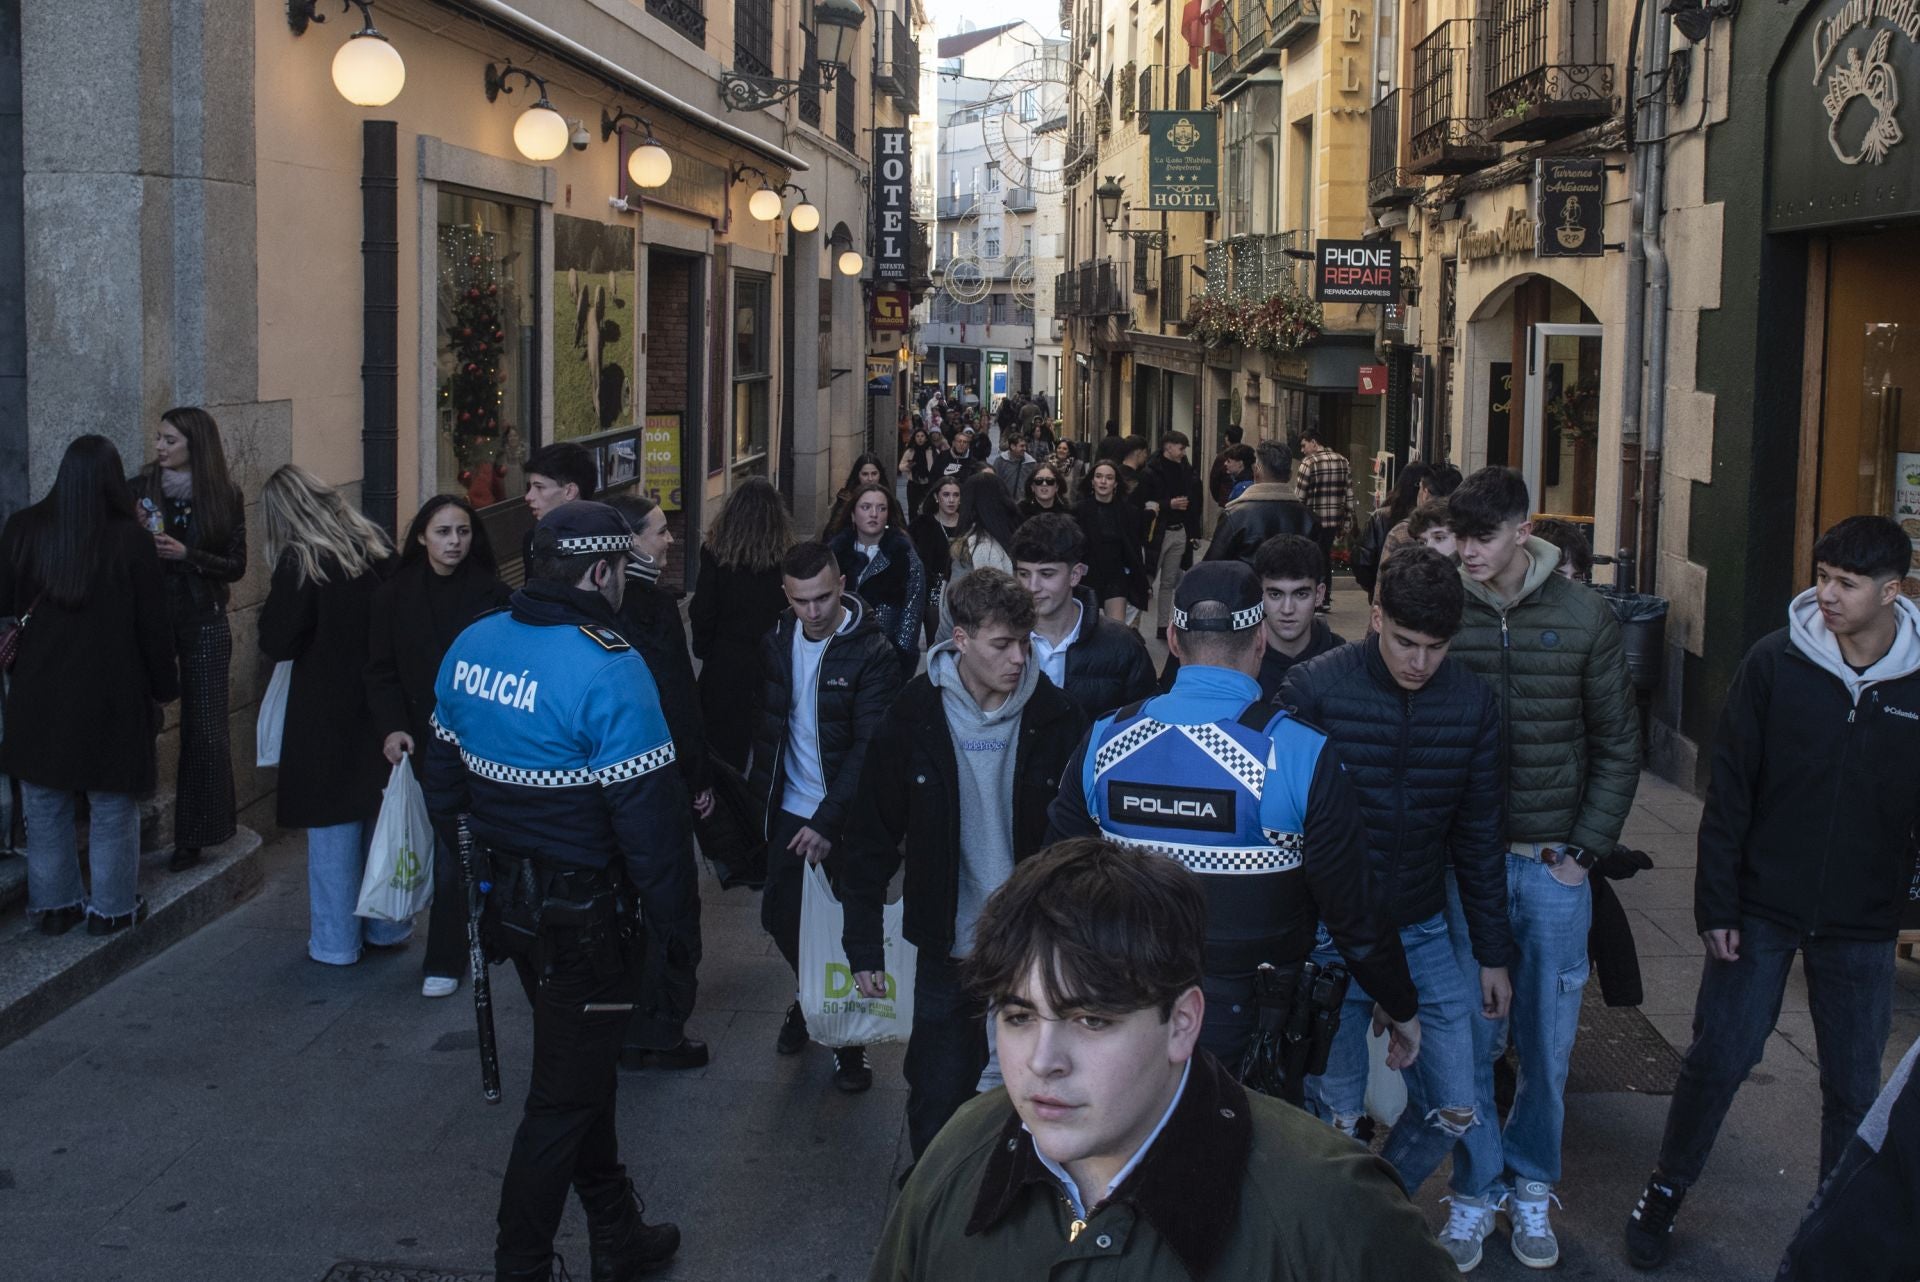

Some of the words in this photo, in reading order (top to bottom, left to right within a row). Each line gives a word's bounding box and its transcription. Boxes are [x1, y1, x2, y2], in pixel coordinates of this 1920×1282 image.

[1546, 180, 1600, 193] Artesanos
[882, 133, 904, 258] HOTEL
[1154, 193, 1215, 206] HOTEL
[1325, 248, 1391, 267] PHONE
[1325, 267, 1392, 286] REPAIR
[1324, 288, 1362, 296] REPARACIÓN
[1363, 289, 1391, 297] EXPRESS
[868, 363, 892, 374] ATM
[646, 449, 672, 461] rico
[453, 660, 538, 713] POLICÍA
[1889, 706, 1919, 720] Columbia
[1123, 796, 1217, 818] POLICIA
[823, 1001, 867, 1015] 50-70%
